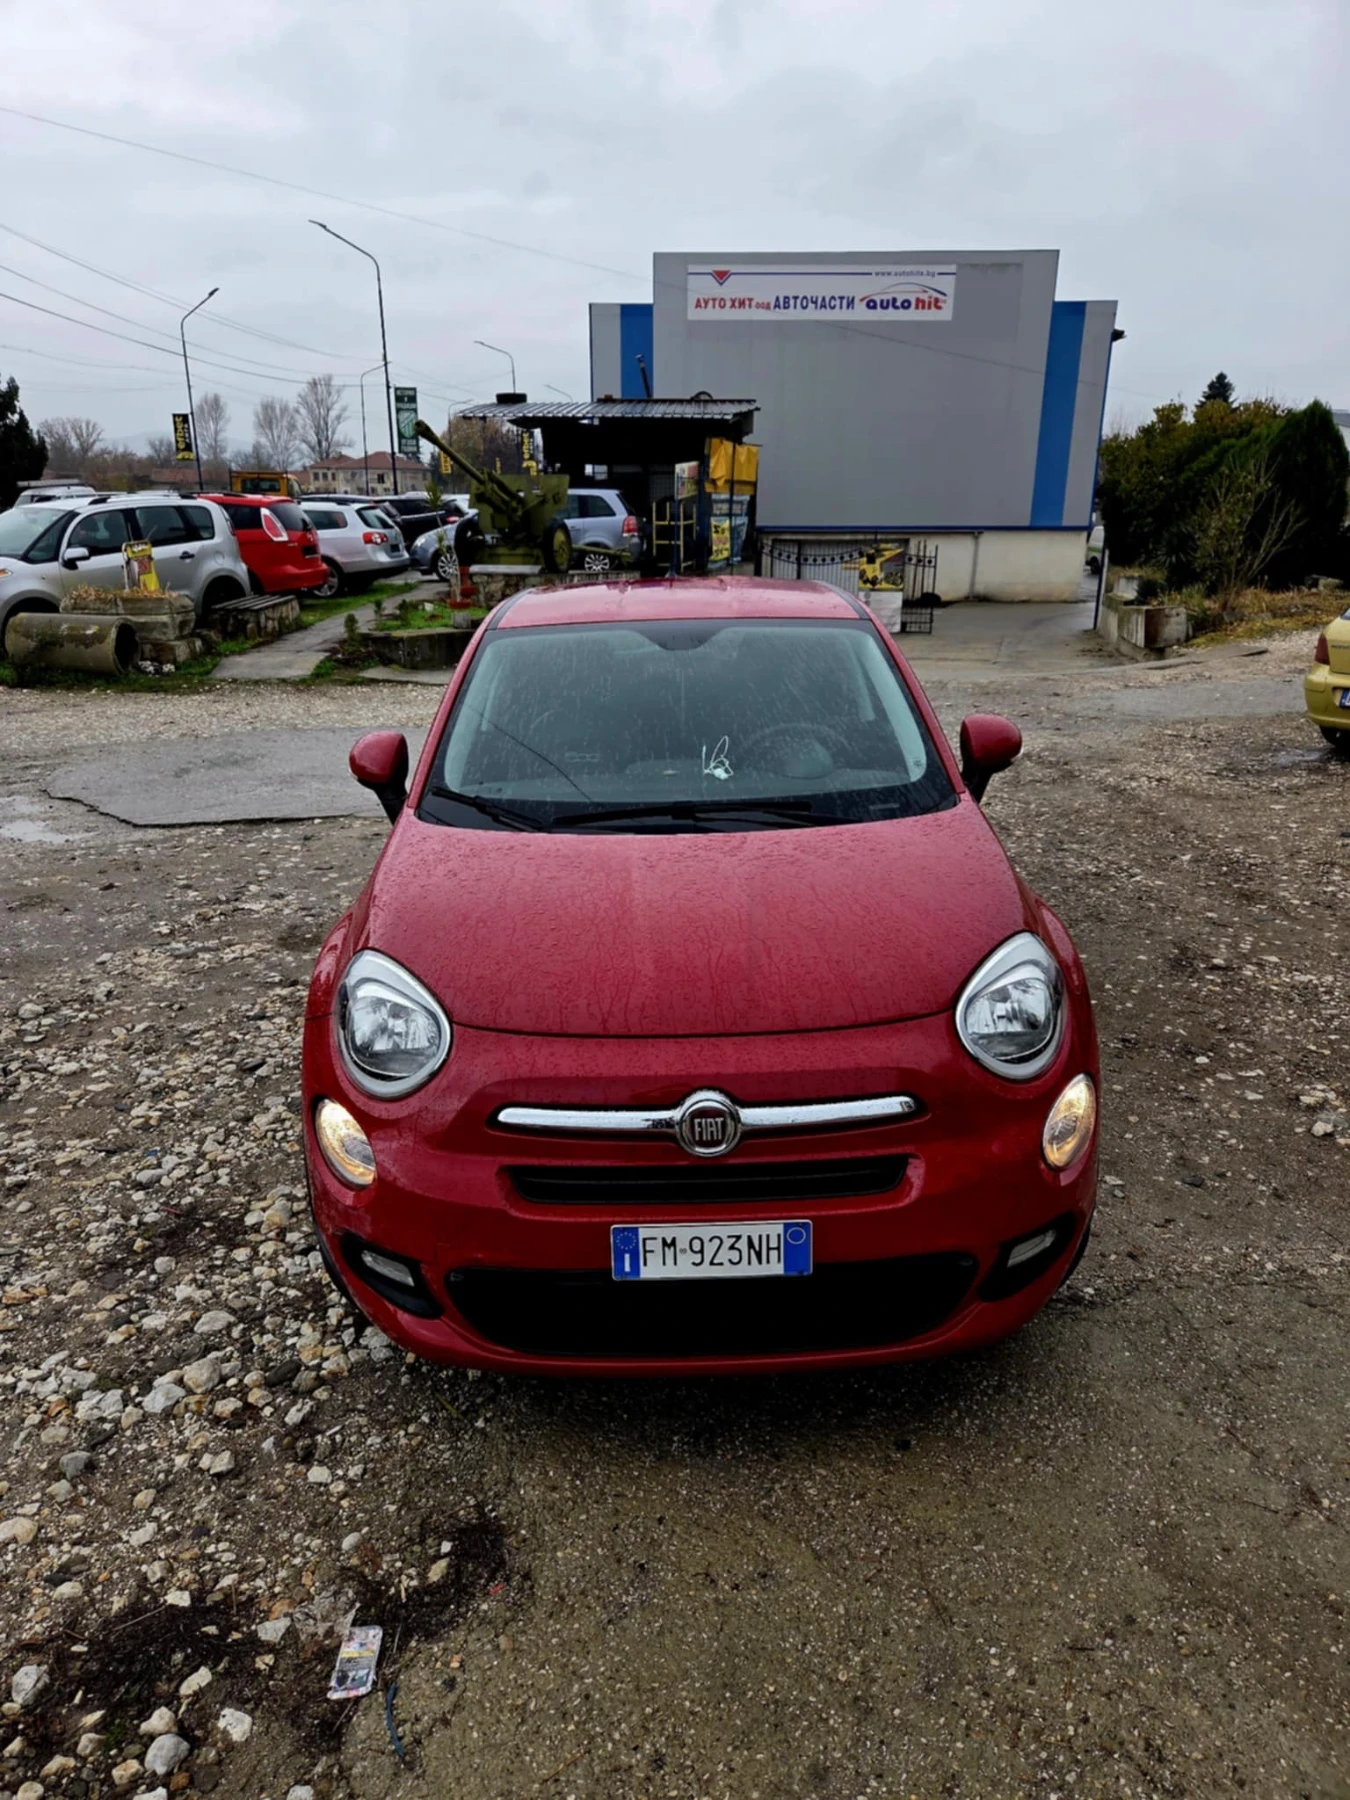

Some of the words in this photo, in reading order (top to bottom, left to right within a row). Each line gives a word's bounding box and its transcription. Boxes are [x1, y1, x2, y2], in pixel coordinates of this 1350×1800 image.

[694, 297, 727, 310] АУТО
[729, 297, 754, 310] ХИТ
[773, 294, 856, 311] АВТОЧАСТИ
[865, 295, 912, 310] auto
[914, 295, 943, 310] hit
[694, 1117, 724, 1141] FIAT
